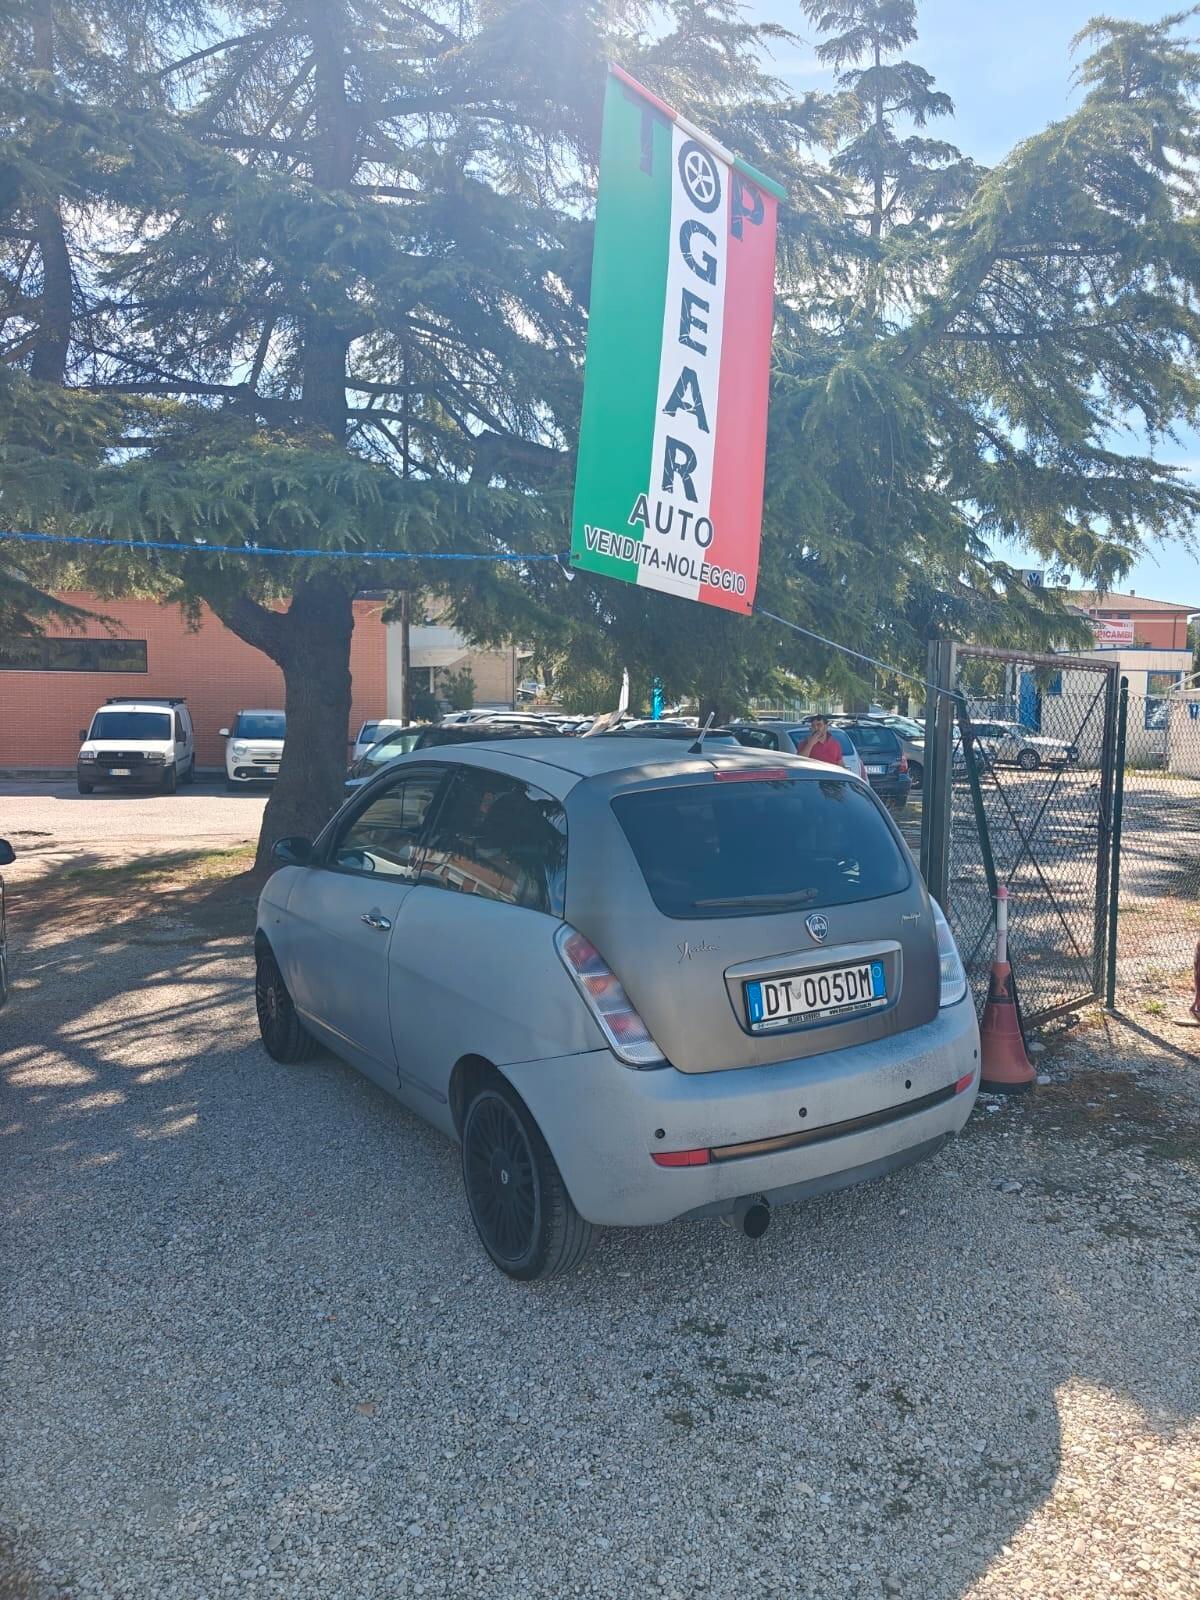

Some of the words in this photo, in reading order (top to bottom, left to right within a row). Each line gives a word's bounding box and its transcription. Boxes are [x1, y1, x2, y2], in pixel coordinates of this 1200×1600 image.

[628, 493, 714, 548] AUTO
[584, 524, 747, 595] VENDITA-NOLEGGIO
[764, 981, 792, 1016] DT
[803, 967, 872, 1008] 005DM
